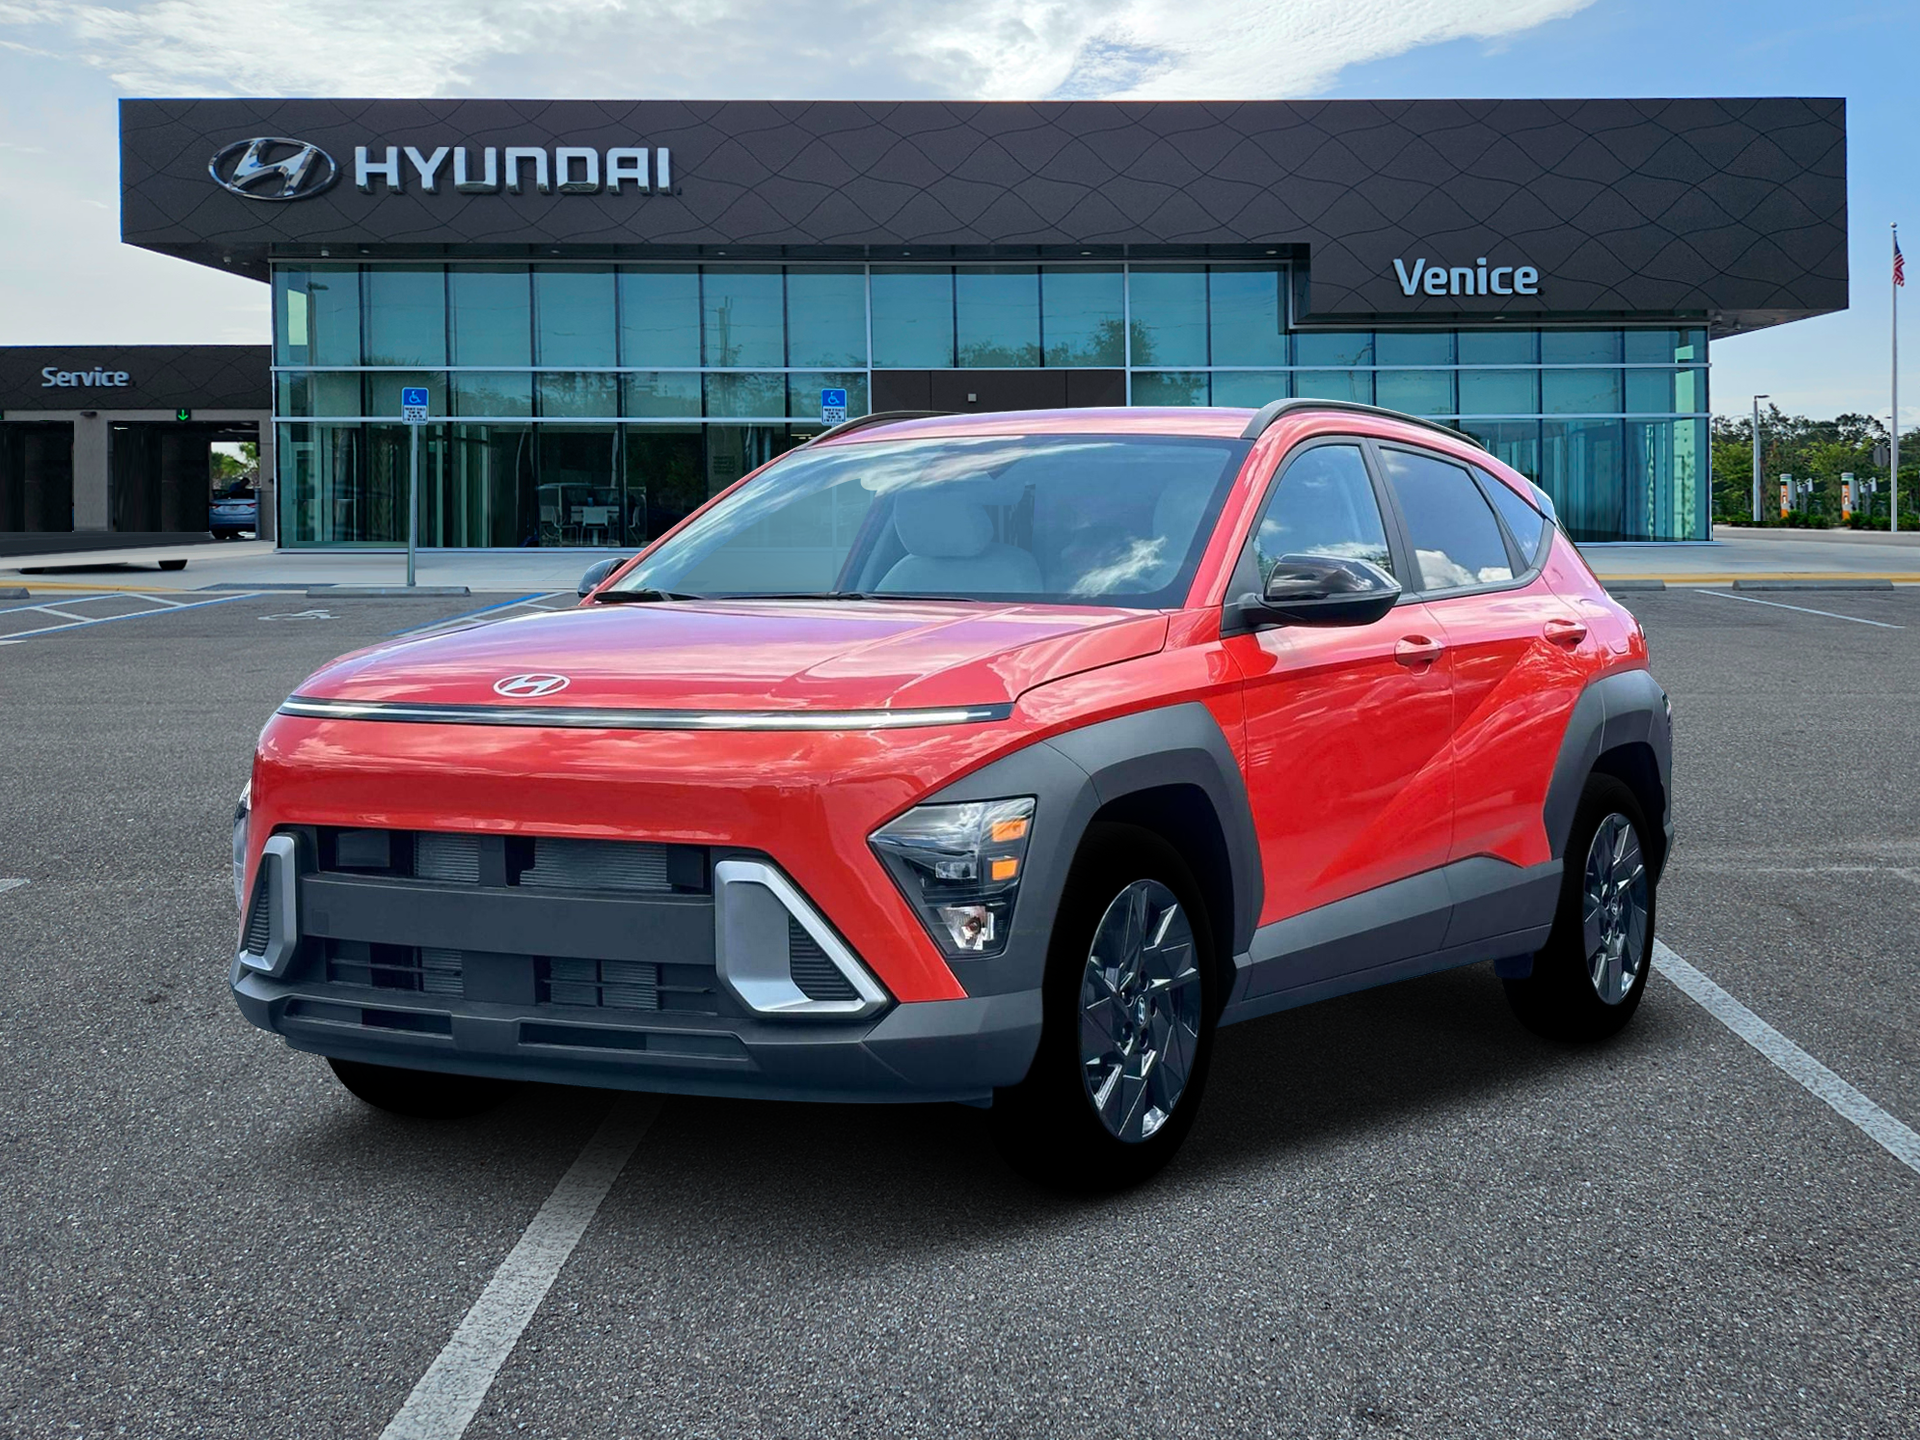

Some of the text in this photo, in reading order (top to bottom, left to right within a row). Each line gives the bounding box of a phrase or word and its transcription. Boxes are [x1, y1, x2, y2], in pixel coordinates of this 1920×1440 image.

[354, 146, 671, 194] HYUNDAI
[1392, 257, 1539, 296] Venice
[41, 366, 130, 388] Service
